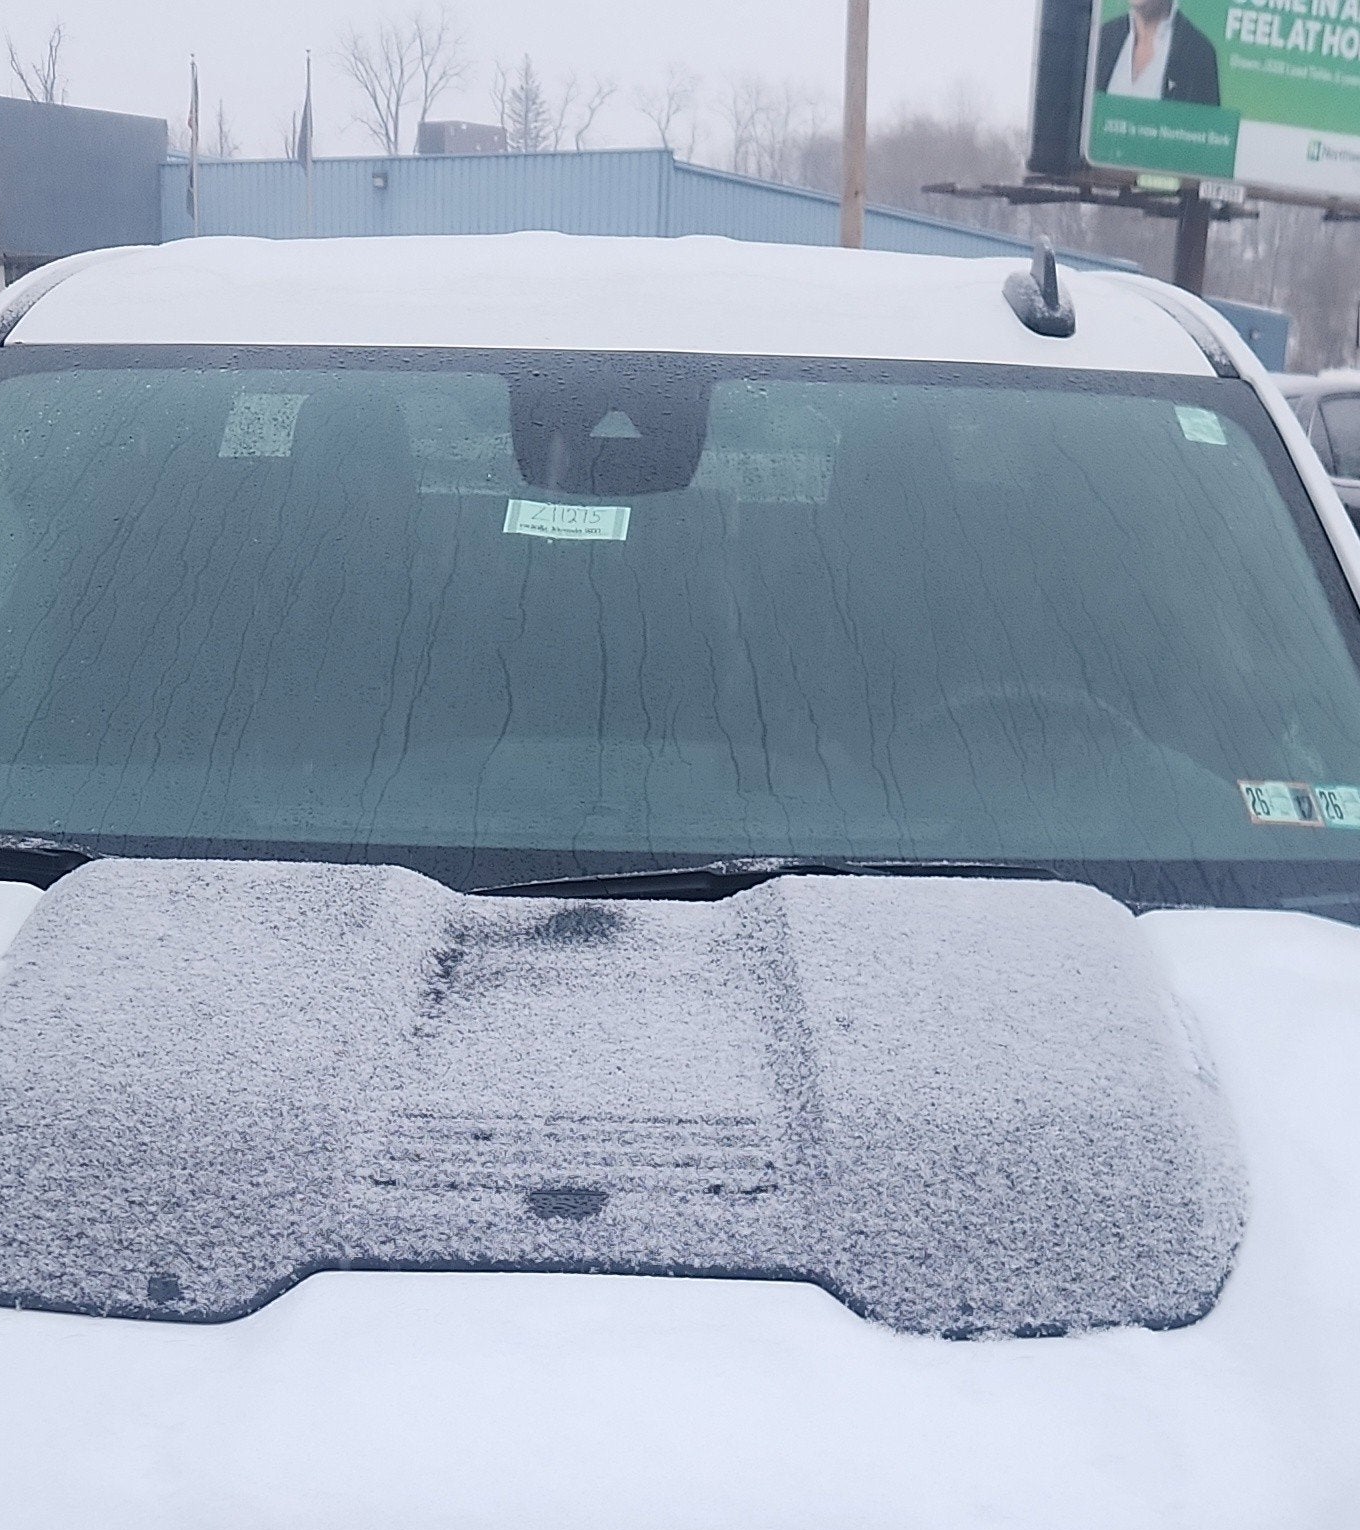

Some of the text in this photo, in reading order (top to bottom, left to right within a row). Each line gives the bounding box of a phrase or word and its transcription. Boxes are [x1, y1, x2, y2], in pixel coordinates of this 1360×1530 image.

[1225, 8, 1285, 48] FEEL
[1287, 18, 1322, 53] AT
[1245, 787, 1271, 816] 26
[1318, 790, 1344, 820] 26
